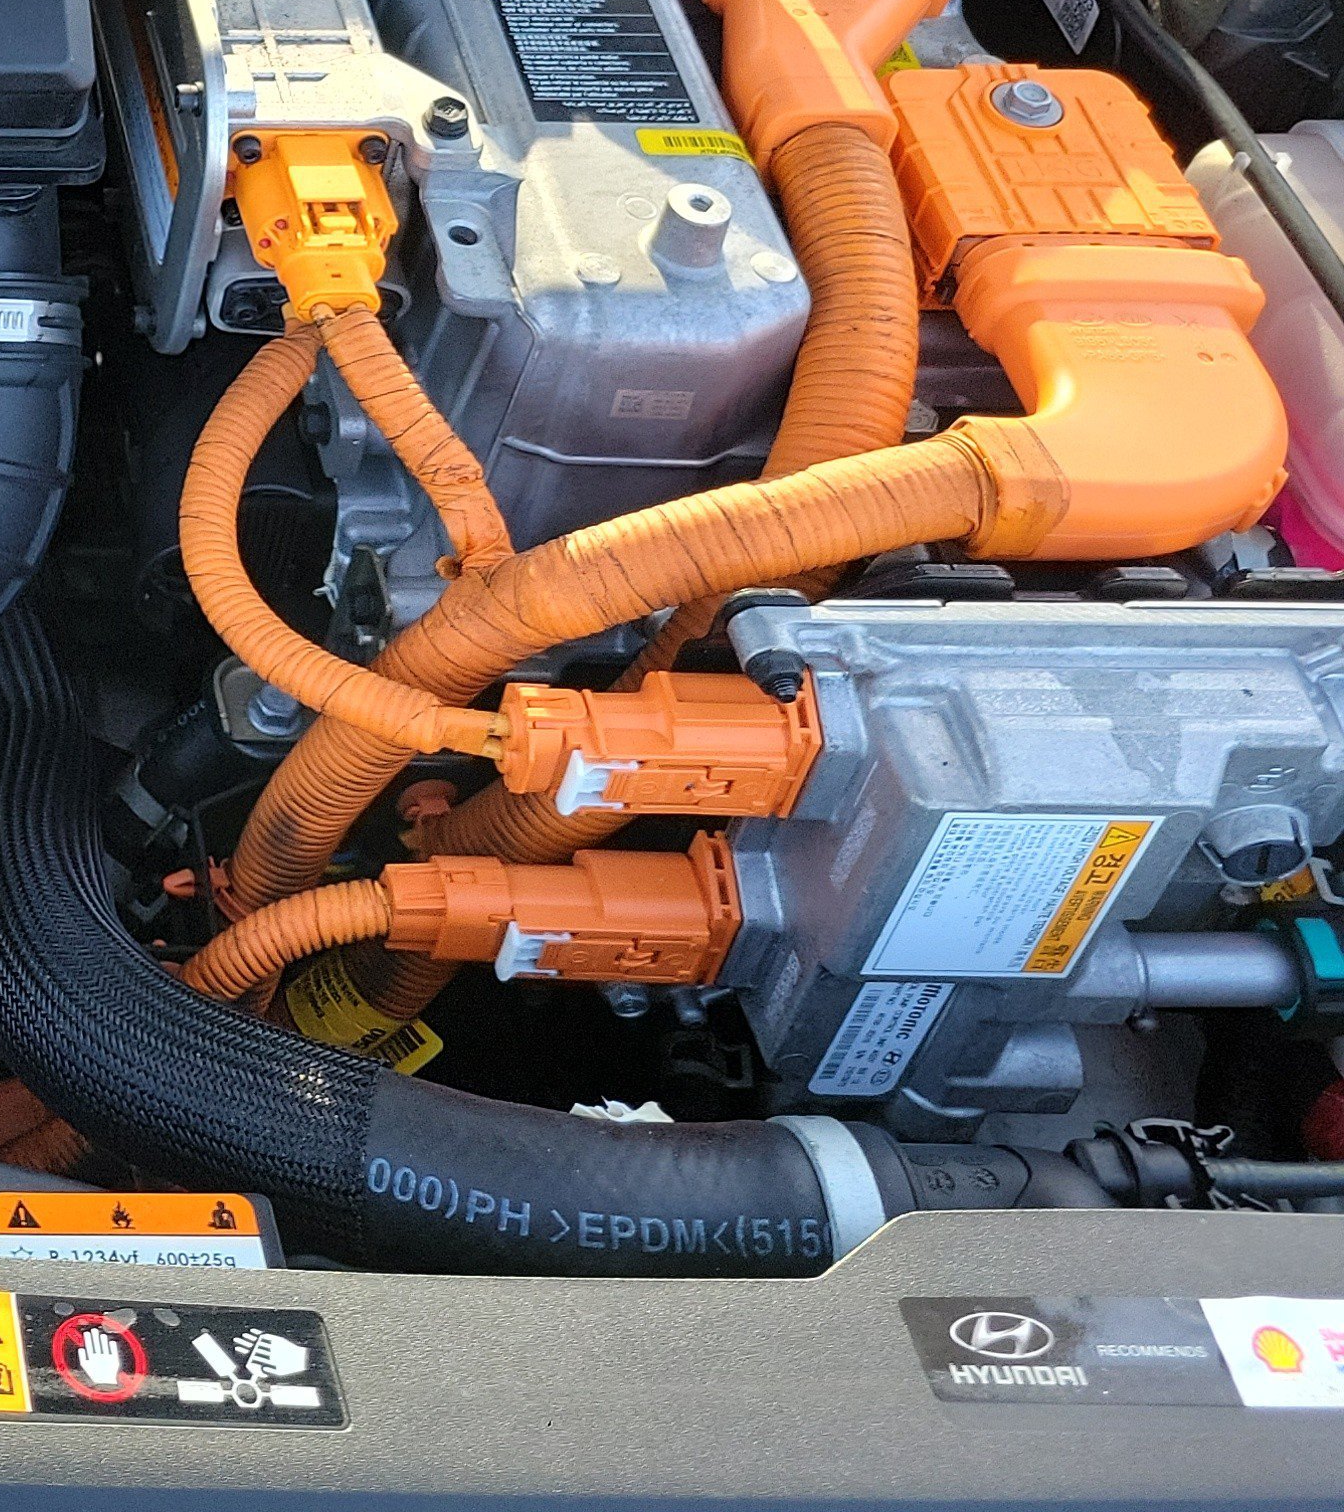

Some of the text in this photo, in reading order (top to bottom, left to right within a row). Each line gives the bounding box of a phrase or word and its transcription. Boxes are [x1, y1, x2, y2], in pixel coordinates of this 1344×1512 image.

[1084, 854, 1126, 885] 경고
[1095, 1344, 1209, 1359] RECOMMENDS
[949, 1362, 1089, 1387] HYUNDAI
